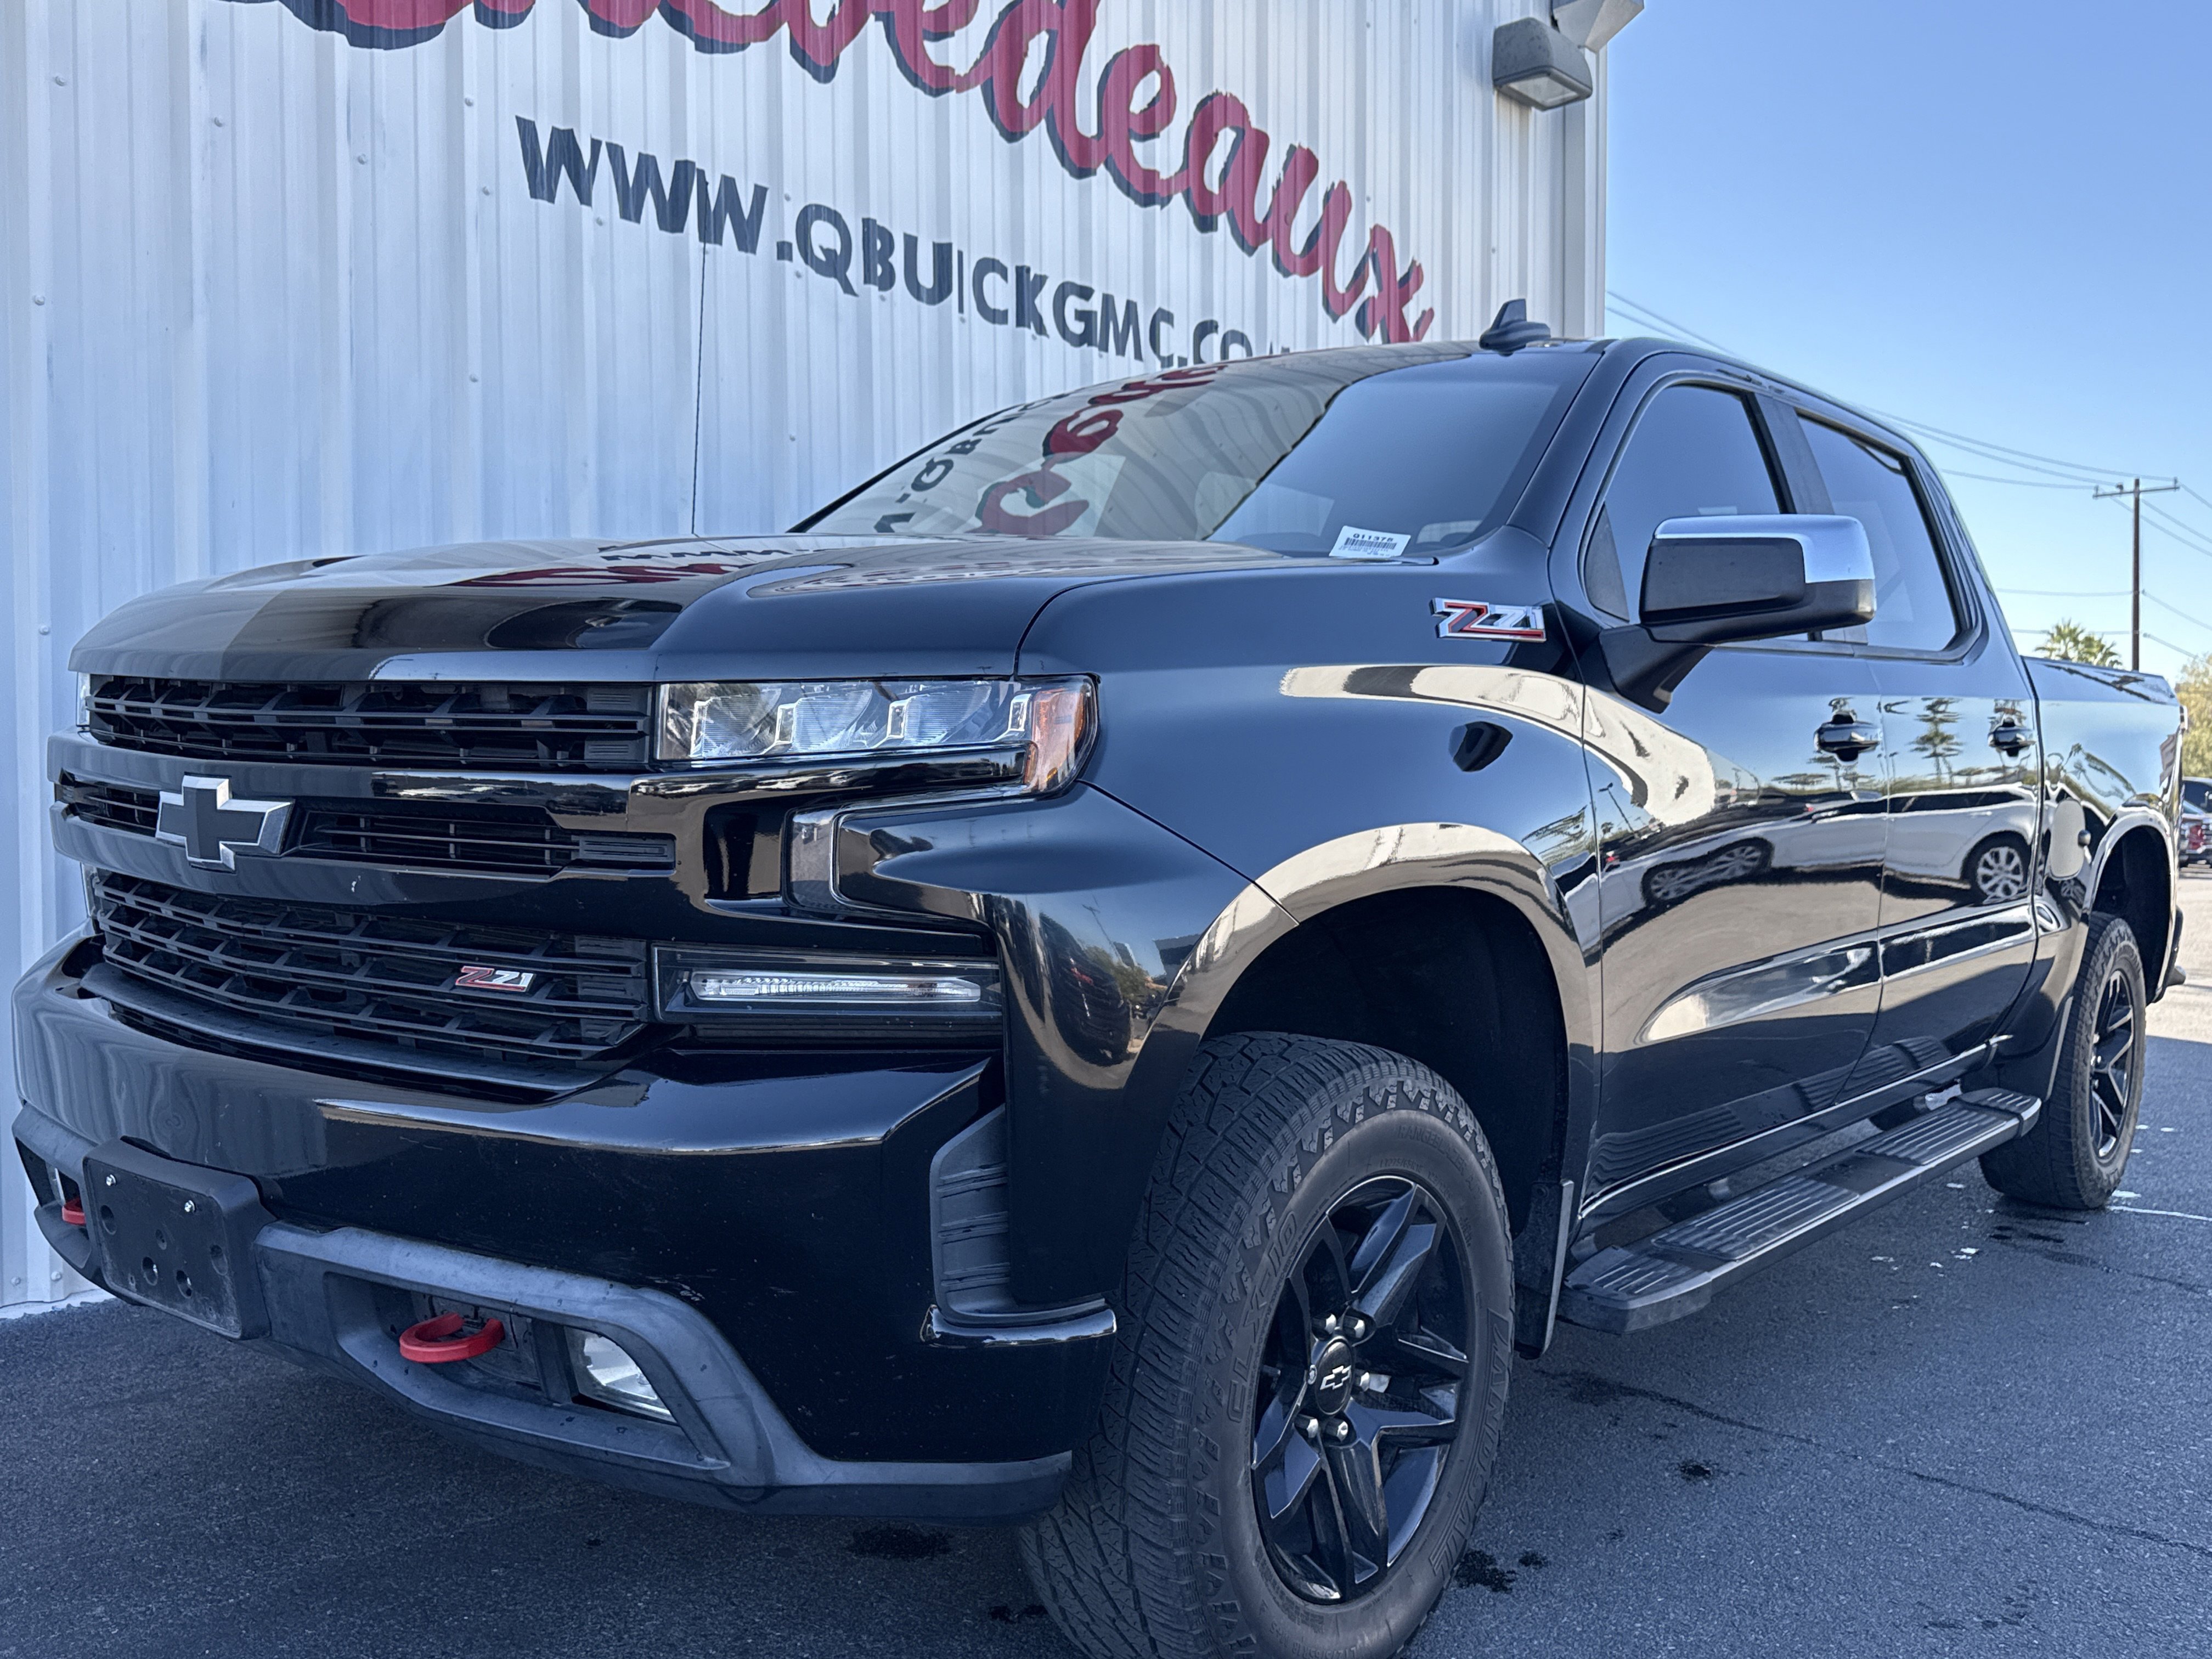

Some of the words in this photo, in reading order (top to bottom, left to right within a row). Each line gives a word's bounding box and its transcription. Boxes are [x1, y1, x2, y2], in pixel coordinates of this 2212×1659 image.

[515, 115, 1290, 368] WWW.QBUICKGMC.CO
[1429, 597, 1546, 642] Z71
[455, 966, 534, 992] Z71
